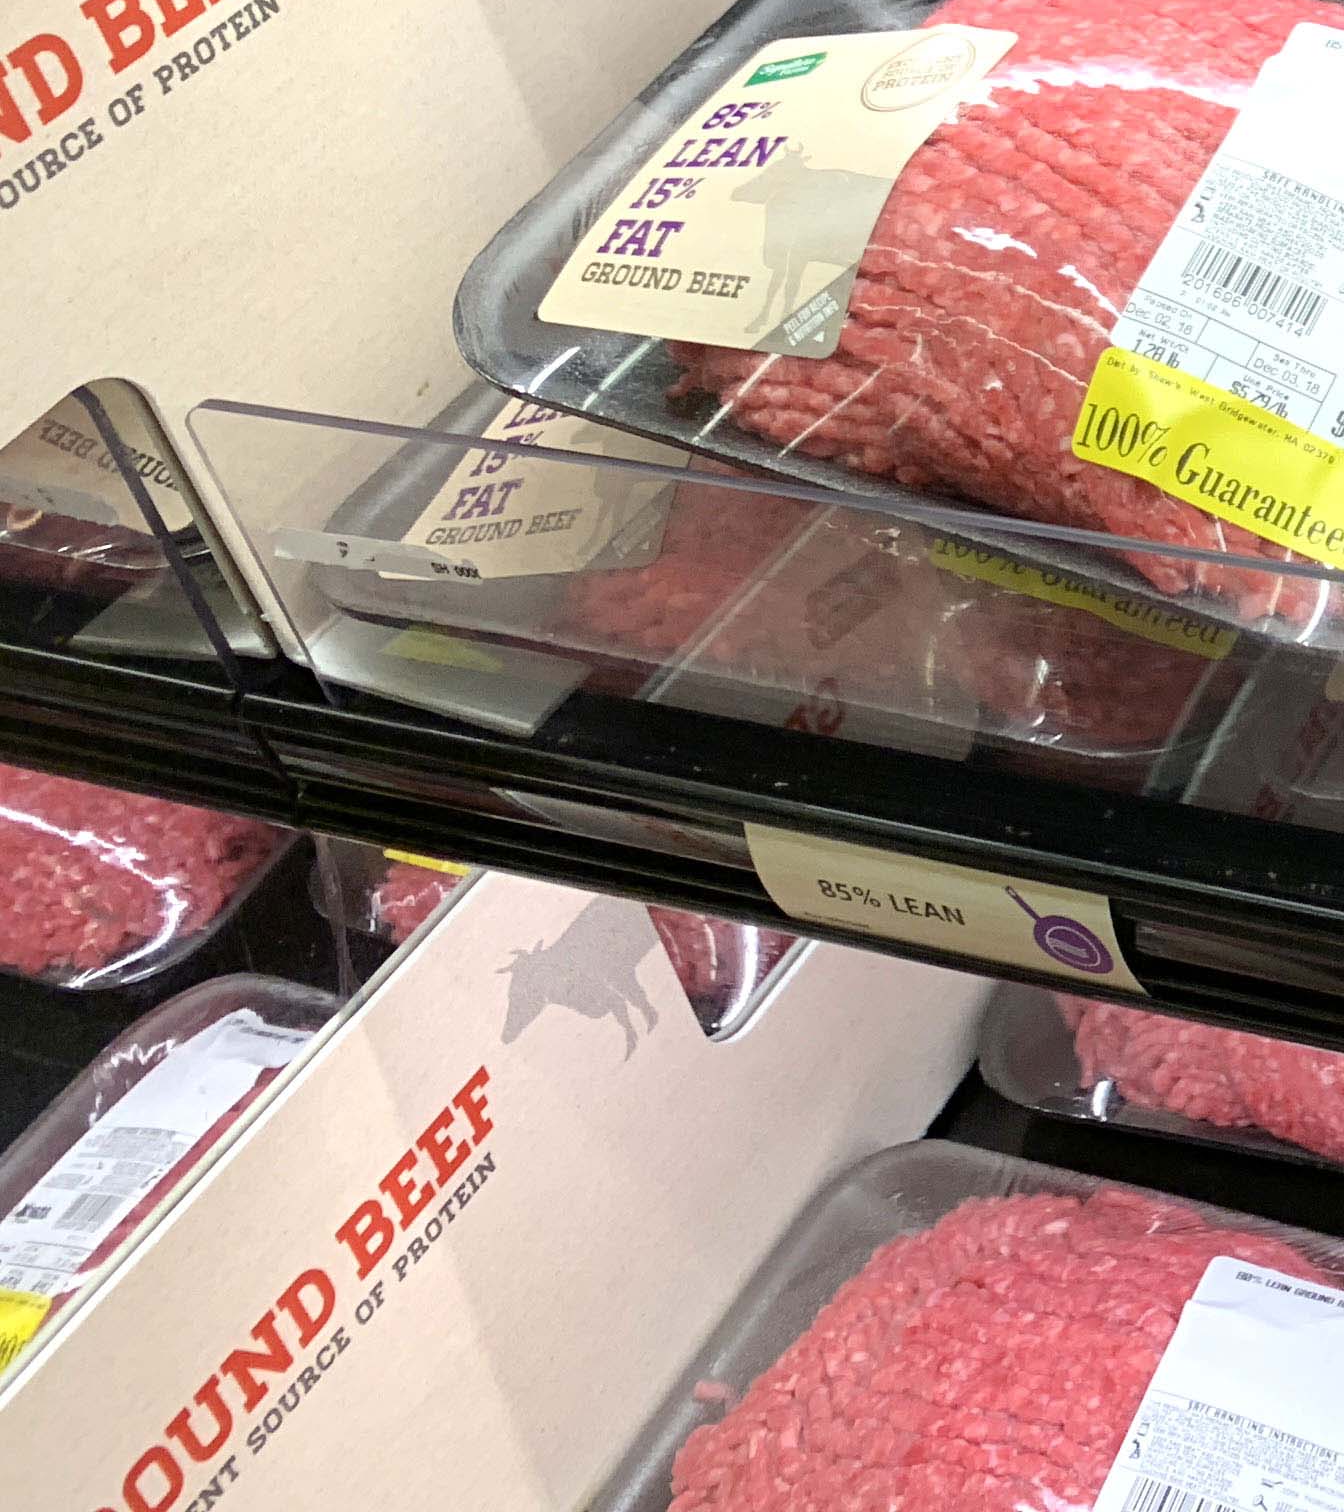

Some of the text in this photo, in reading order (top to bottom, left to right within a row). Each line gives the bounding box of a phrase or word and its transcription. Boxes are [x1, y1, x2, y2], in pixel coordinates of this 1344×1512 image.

[107, 83, 146, 127] OF
[702, 101, 782, 130] 85%
[664, 136, 787, 168] LEAN
[629, 178, 706, 209] 15%
[597, 220, 684, 258] FAT
[581, 263, 750, 299] GROUND BEEF
[1125, 302, 1151, 321] Dec
[1253, 357, 1279, 377] Dec
[1076, 402, 1172, 468] 100%
[442, 478, 524, 520] FAT
[425, 508, 583, 546] GROUND BEEF
[818, 878, 881, 909] 85%
[888, 893, 966, 927] LEAN
[93, 1268, 336, 1512] OUND
[334, 1064, 500, 1281] BEEF
[246, 1326, 351, 1456] SOURCE
[354, 1278, 386, 1326] OF
[394, 1151, 499, 1282] PROTEIN
